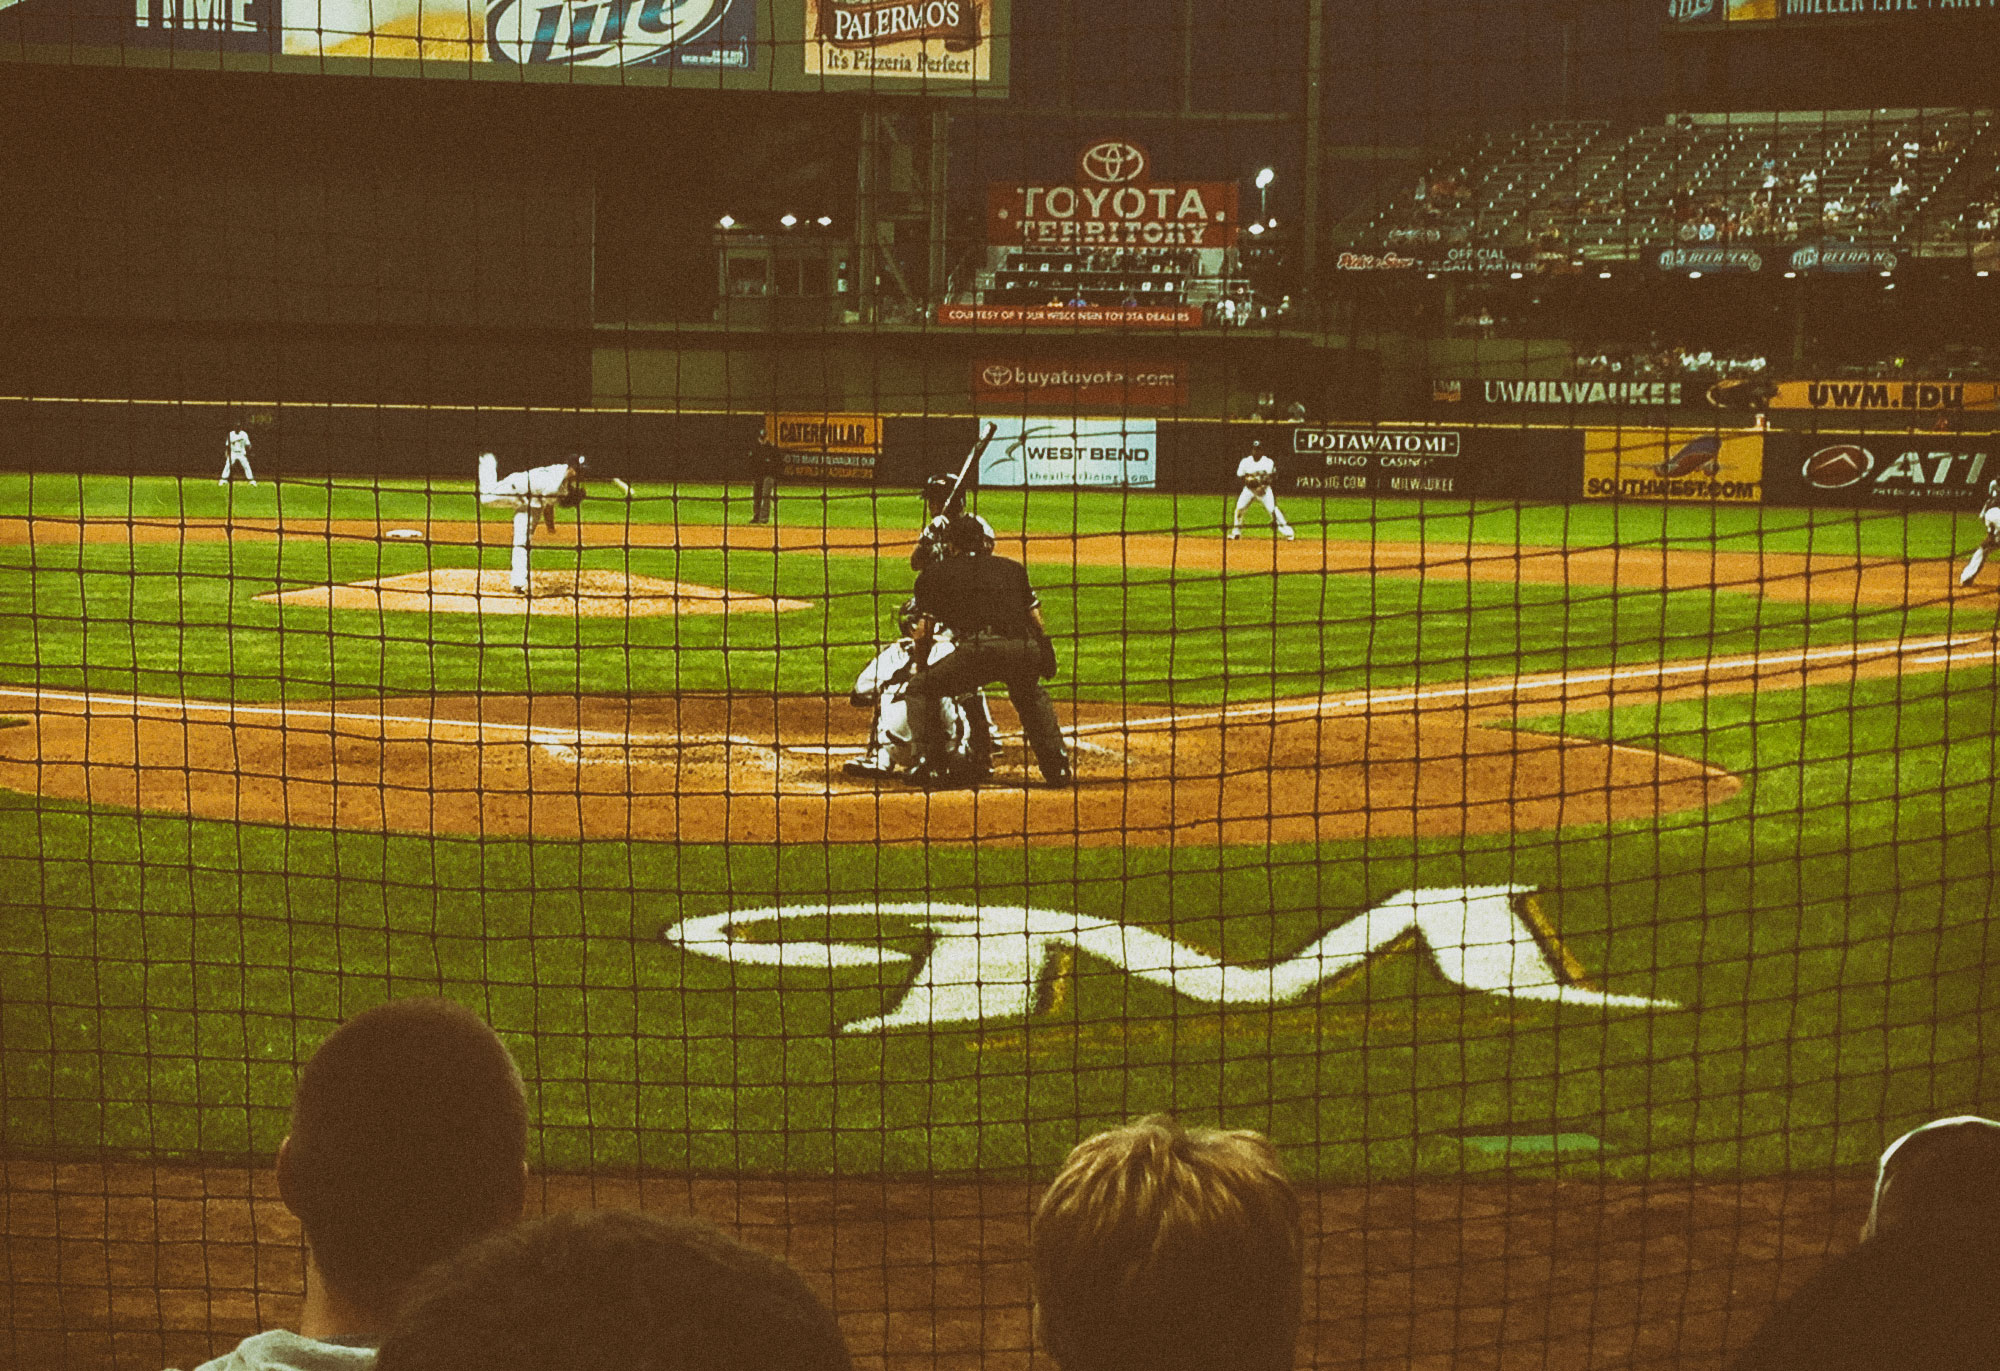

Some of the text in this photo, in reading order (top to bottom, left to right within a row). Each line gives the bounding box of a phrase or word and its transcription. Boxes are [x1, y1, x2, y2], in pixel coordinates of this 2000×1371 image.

[834, 1, 960, 40] PALERMO'S
[827, 49, 849, 70] It's
[917, 52, 970, 74] Perfect
[1016, 186, 1209, 219] TOYOTA
[1016, 220, 1209, 244] TERRITORY
[1448, 248, 1506, 260] OFFCIAL
[1307, 433, 1446, 452] POTAWATOMI
[1028, 447, 1149, 461] WEST BEND
[1326, 456, 1434, 467] BINGO CASIN
[1587, 478, 1757, 498] SOUTHWEST.COM
